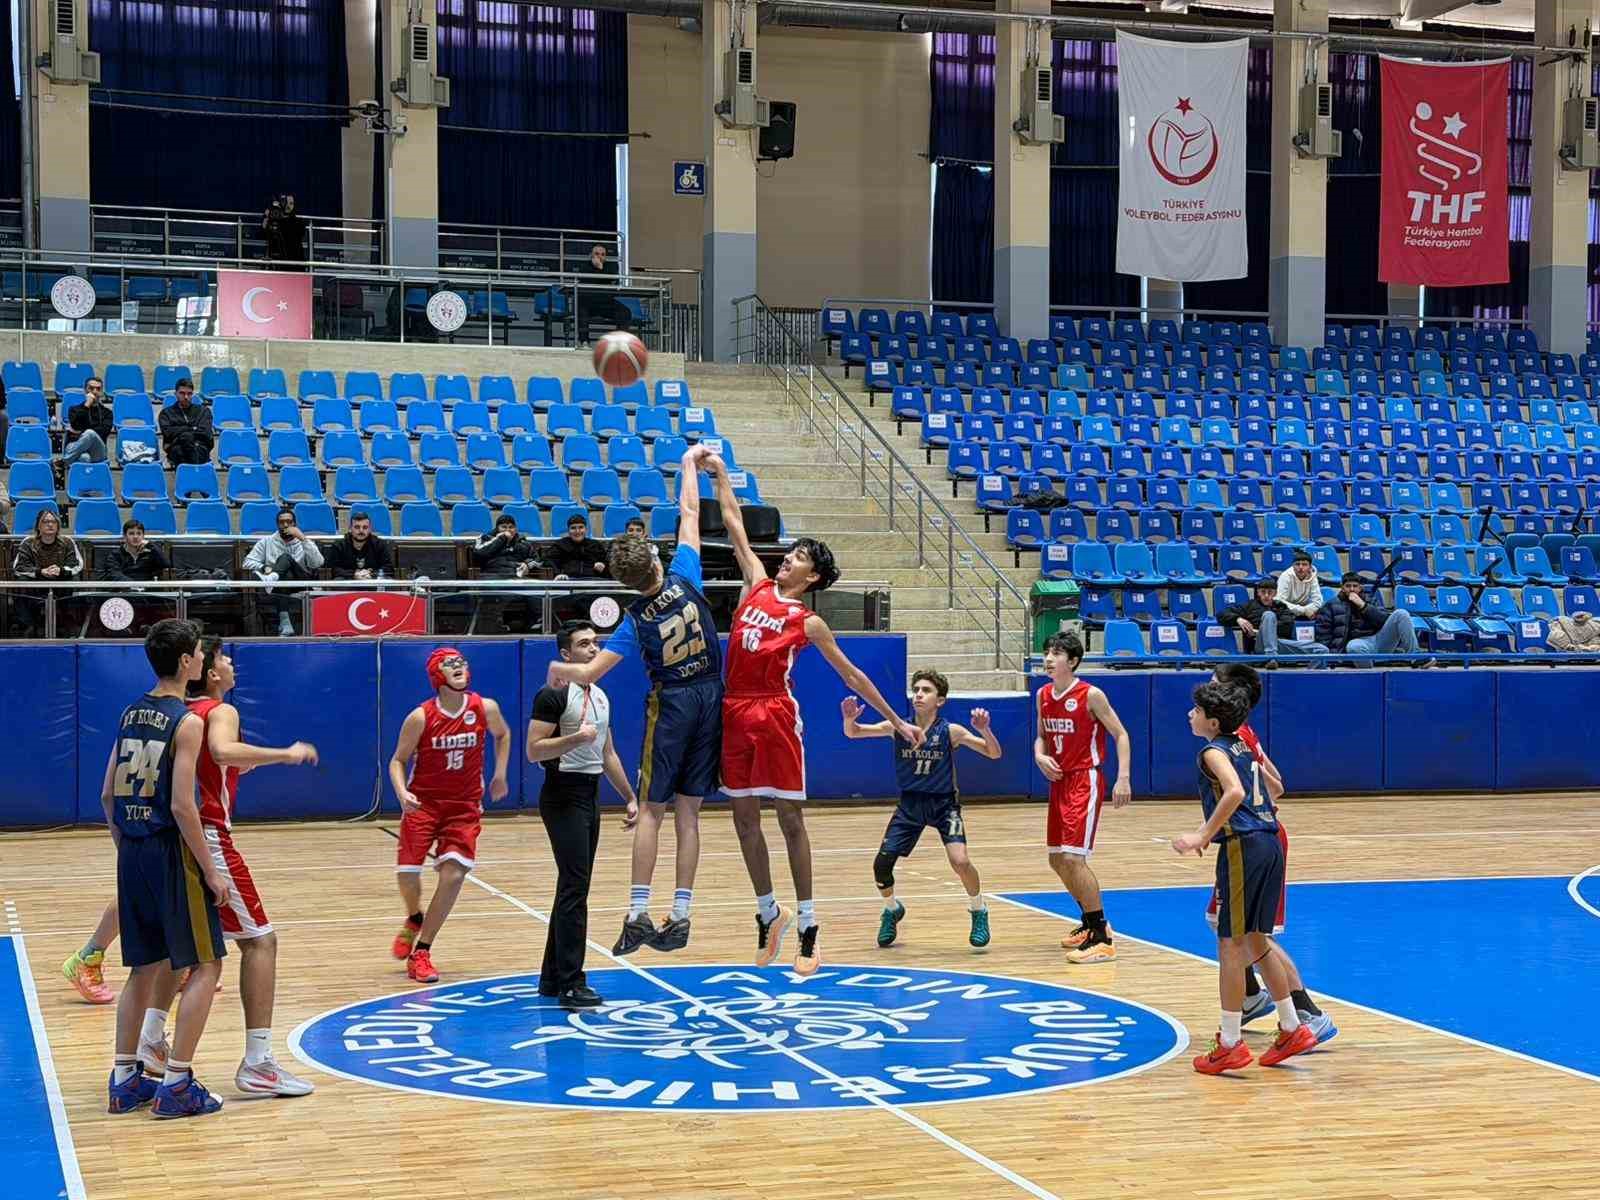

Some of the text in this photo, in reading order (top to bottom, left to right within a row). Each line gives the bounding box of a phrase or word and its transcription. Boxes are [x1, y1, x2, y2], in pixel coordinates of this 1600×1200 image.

[1124, 207, 1241, 222] VOLEYBOL FEDERASYONU
[1162, 198, 1205, 209] TÜRKİYE
[1407, 190, 1486, 224] THF
[1403, 236, 1472, 249] Federasyonu
[1404, 226, 1483, 239] Türkiye Hentbol
[658, 600, 706, 667] 23
[742, 628, 762, 653] 16
[113, 738, 166, 797] 24
[445, 750, 464, 770] 15
[914, 760, 932, 775] 11
[701, 971, 1020, 999] AYDIN
[342, 983, 548, 1089] BELEDİYES
